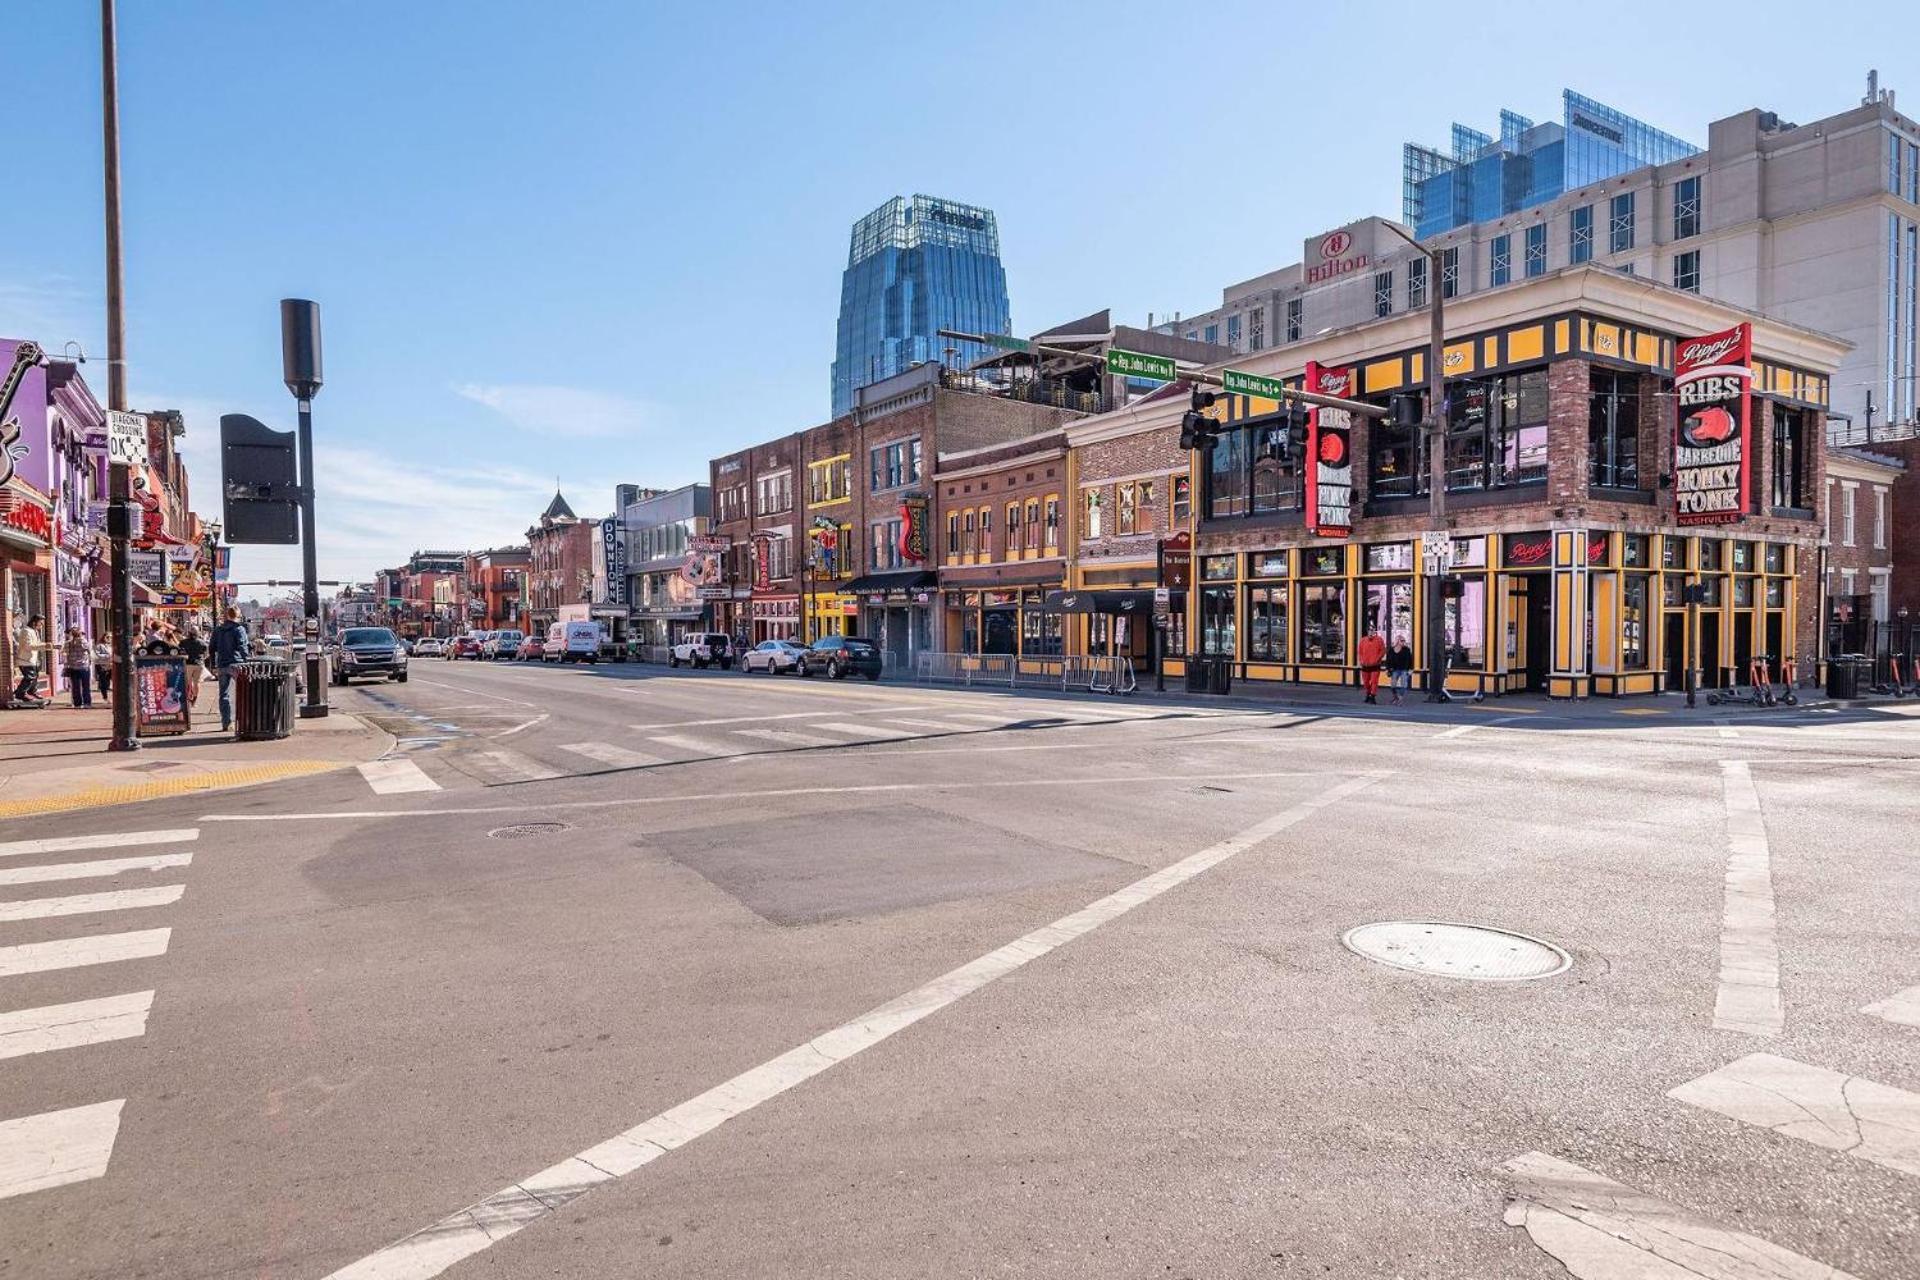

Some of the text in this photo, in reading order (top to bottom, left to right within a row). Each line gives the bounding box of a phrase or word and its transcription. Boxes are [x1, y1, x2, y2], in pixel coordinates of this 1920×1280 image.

[1308, 255, 1368, 284] Hilton
[1677, 327, 1742, 364] Rippy's
[1130, 357, 1143, 371] John
[1144, 359, 1159, 374] Lewis
[1235, 375, 1247, 389] John
[1248, 377, 1261, 391] Lewis
[1679, 377, 1740, 406] RIBS
[112, 414, 142, 426] DIAGONAL
[1318, 407, 1351, 429] RIBS
[112, 424, 143, 437] CROSSING
[110, 437, 126, 456] OK
[1676, 437, 1742, 468] BARBEQUE
[1677, 465, 1740, 492] HONKY
[1677, 488, 1739, 513] TONK
[1680, 514, 1738, 525] NASHVILLE
[1423, 544, 1433, 554] OK
[605, 522, 616, 599] DOWNTOWN
[1174, 556, 1190, 564] District
